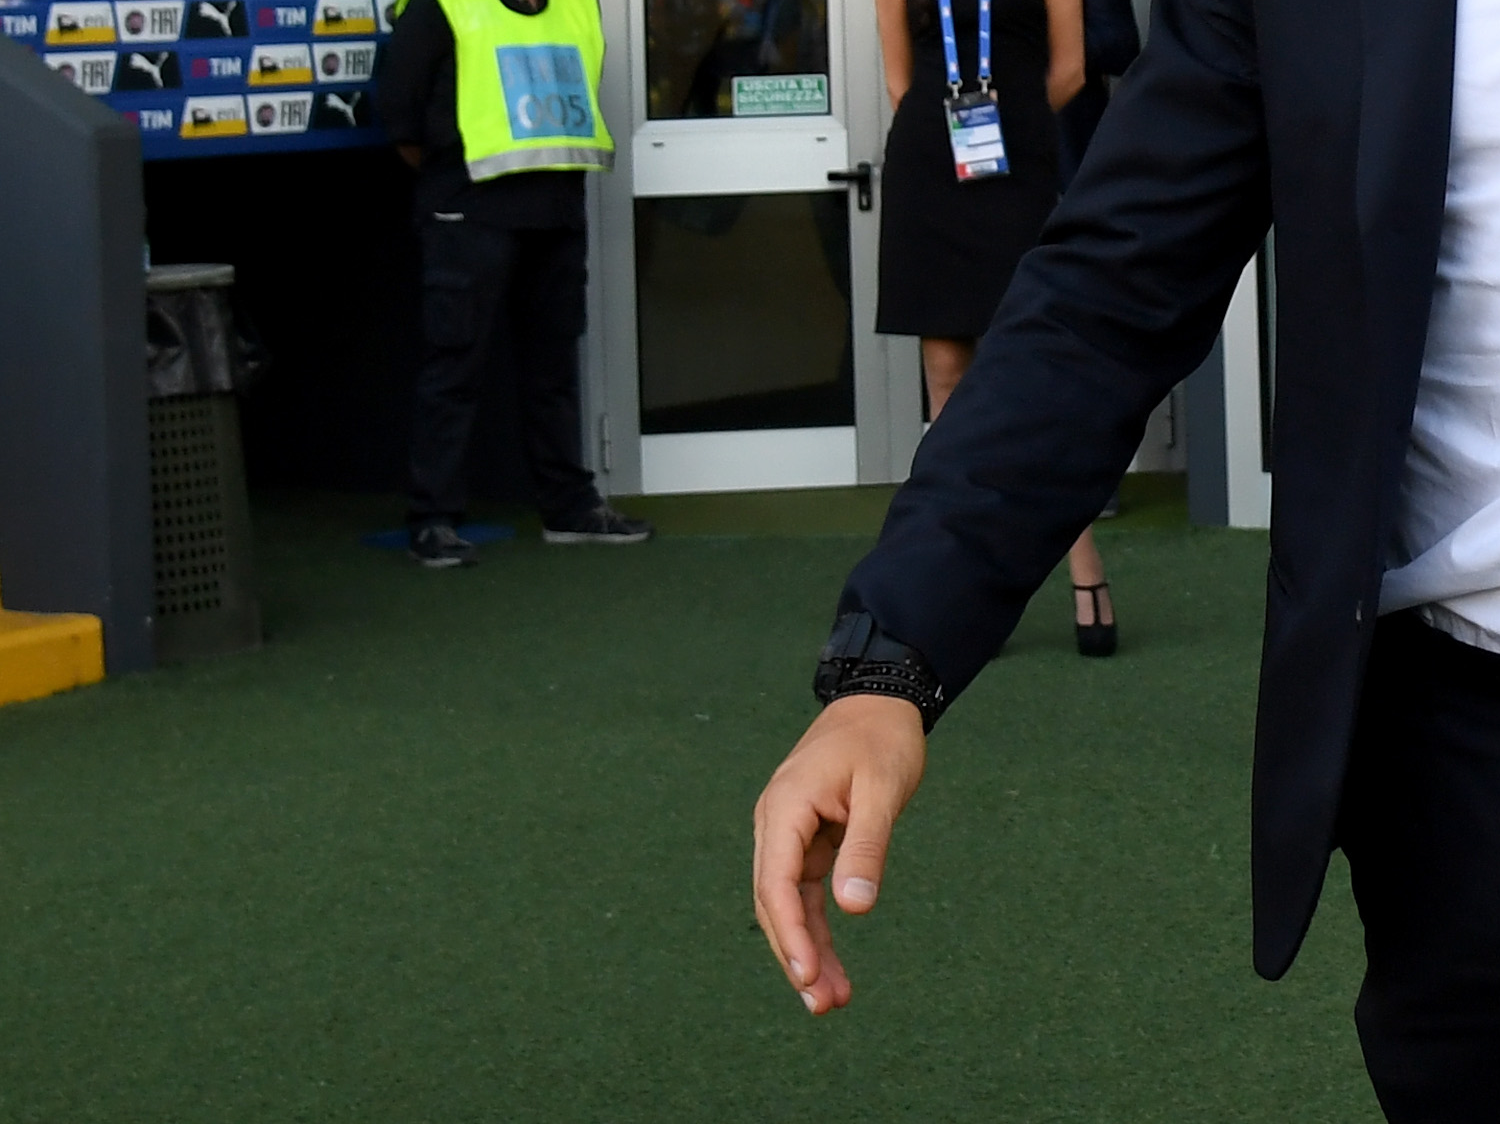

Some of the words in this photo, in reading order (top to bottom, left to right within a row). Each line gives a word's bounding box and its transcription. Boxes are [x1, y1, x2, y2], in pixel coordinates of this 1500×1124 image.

[3, 15, 37, 35] TIM
[151, 7, 178, 34] FIAT
[276, 7, 307, 26] TIM
[209, 57, 242, 76] TIM
[345, 49, 374, 75] FIAT
[82, 60, 111, 88] FIAT
[742, 79, 798, 91] USCITA
[801, 77, 818, 89] DI
[738, 89, 824, 103] SICUREZZA
[140, 110, 173, 129] TIM
[281, 100, 308, 127] FIAT
[517, 94, 587, 130] 005
